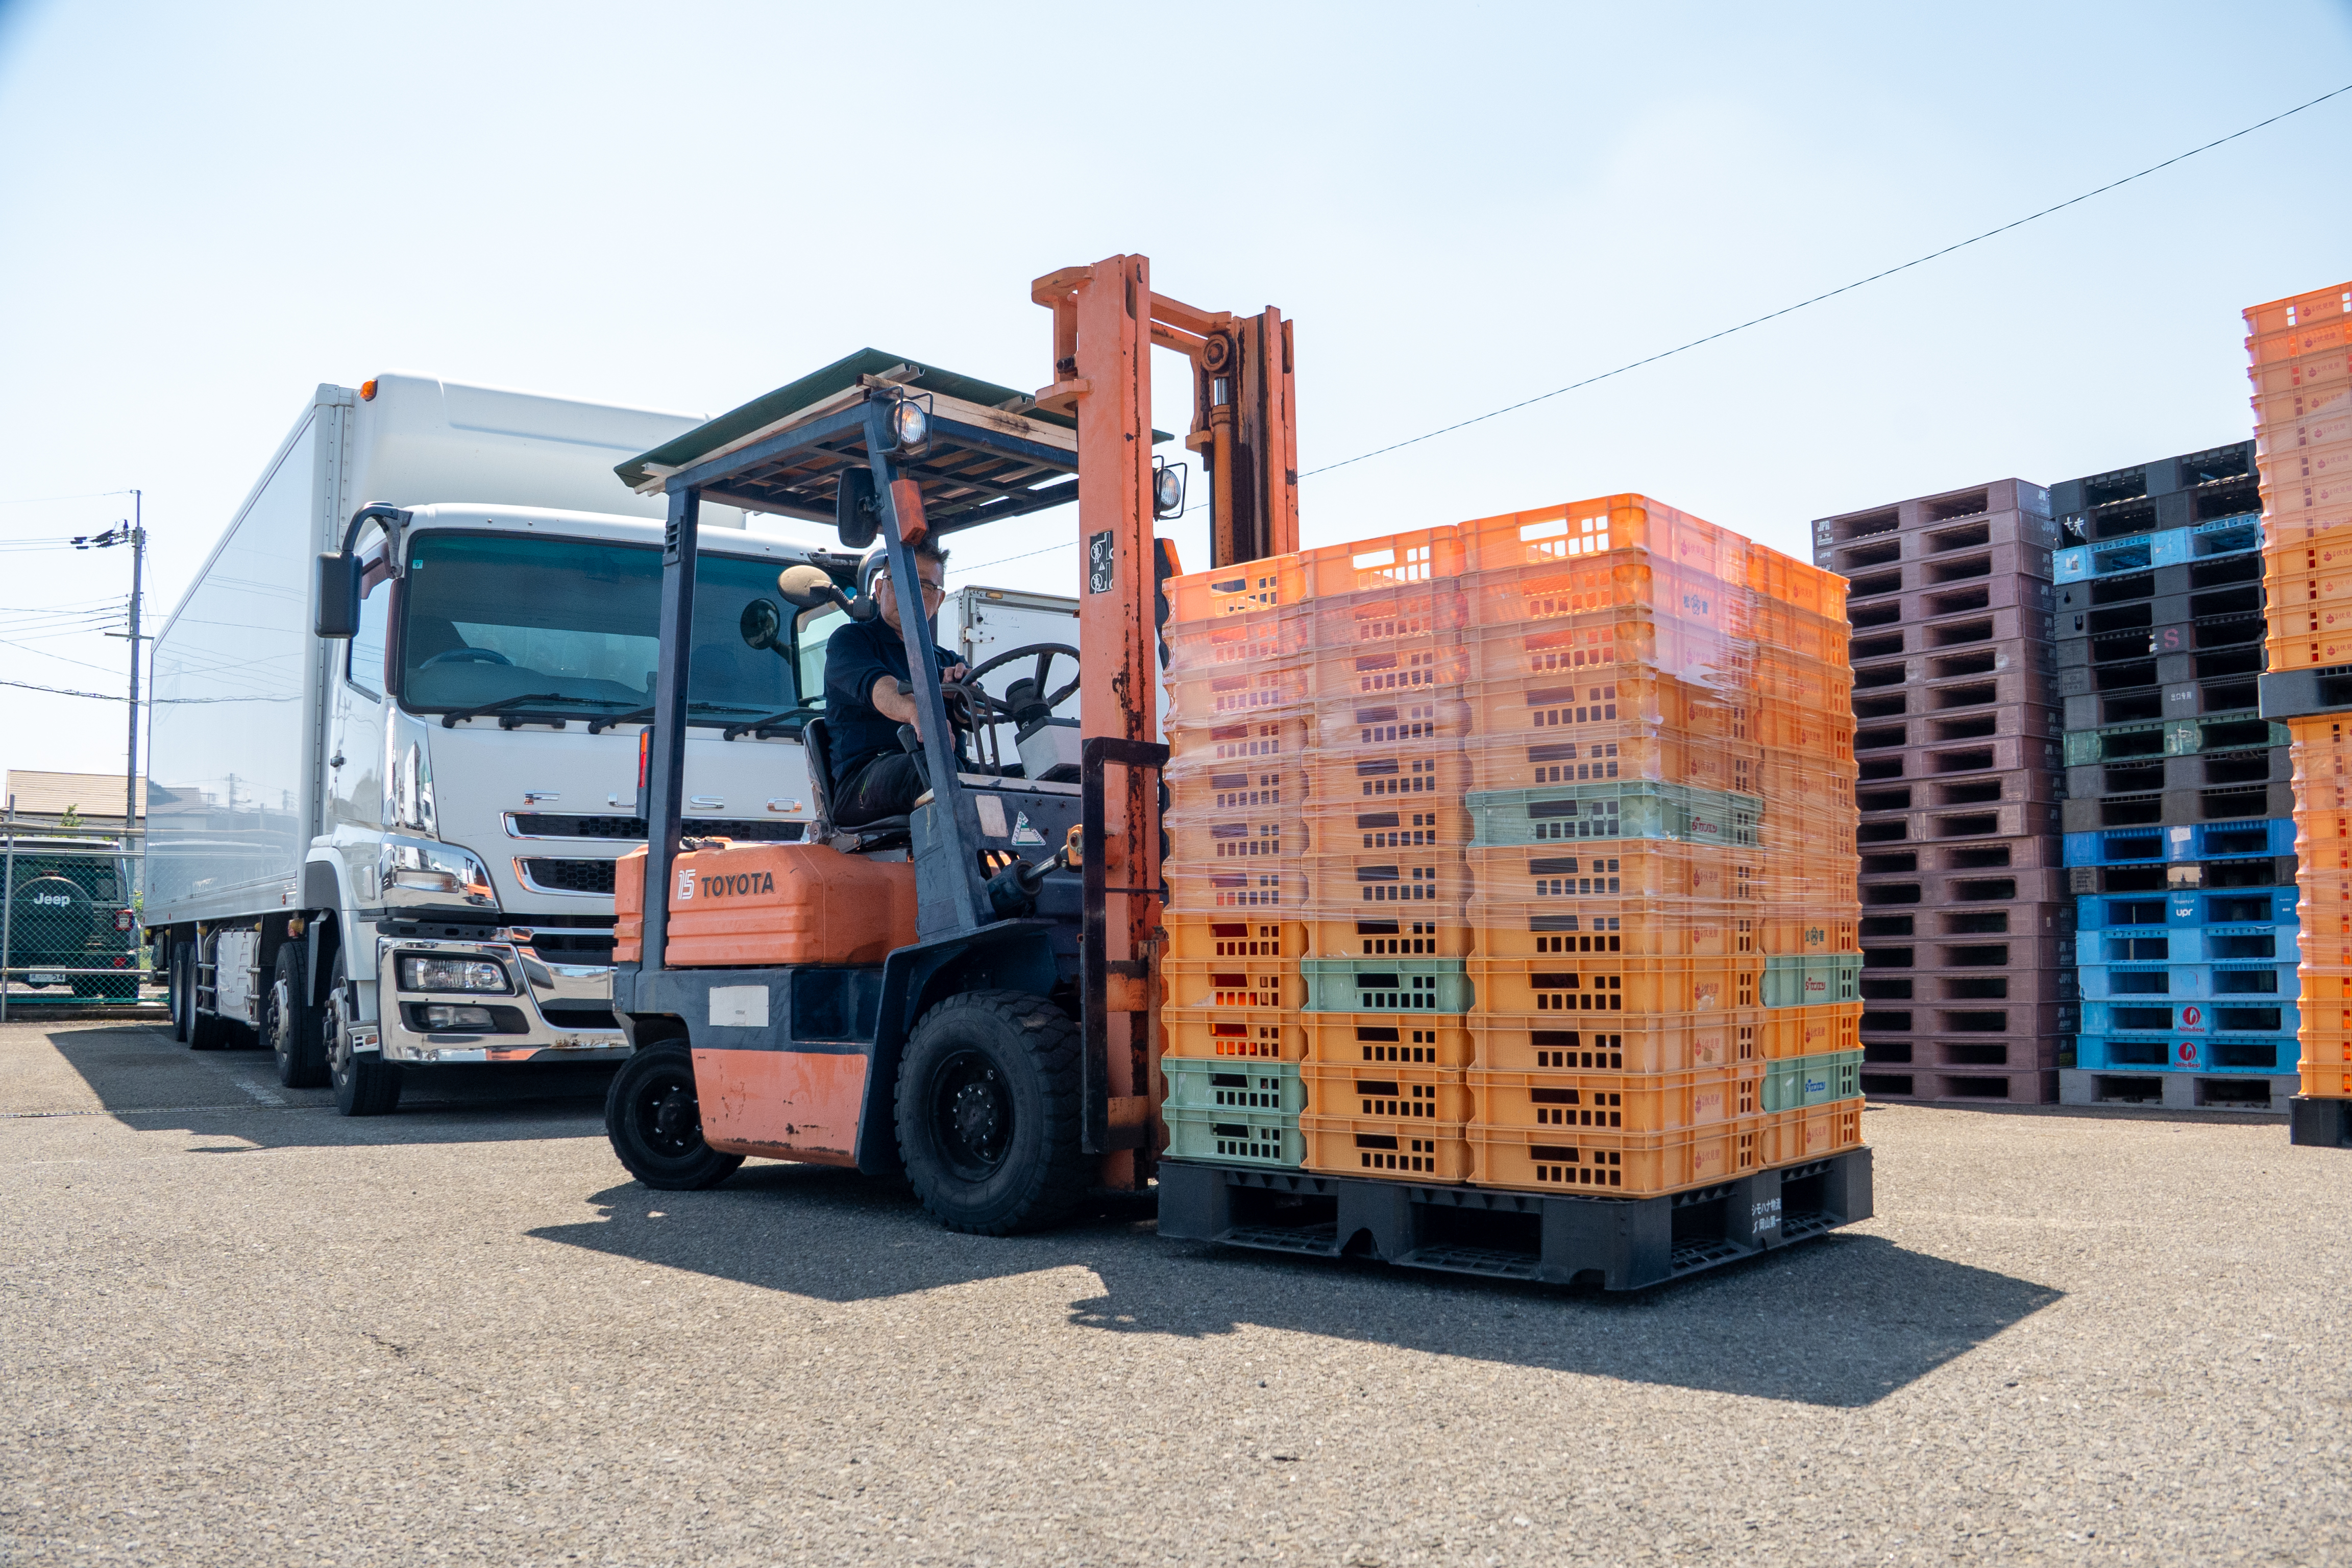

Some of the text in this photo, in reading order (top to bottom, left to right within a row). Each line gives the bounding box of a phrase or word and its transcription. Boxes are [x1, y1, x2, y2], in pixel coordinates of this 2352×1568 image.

[2041, 522, 2055, 534] JPR
[2164, 628, 2179, 649] S
[2171, 692, 2192, 701] 出口专用
[524, 790, 803, 813] FUSO
[677, 869, 774, 899] 15 TOYOTA
[34, 893, 70, 907] Jeep
[2176, 908, 2193, 918] upr
[1751, 1197, 1781, 1216] シモハナ物流
